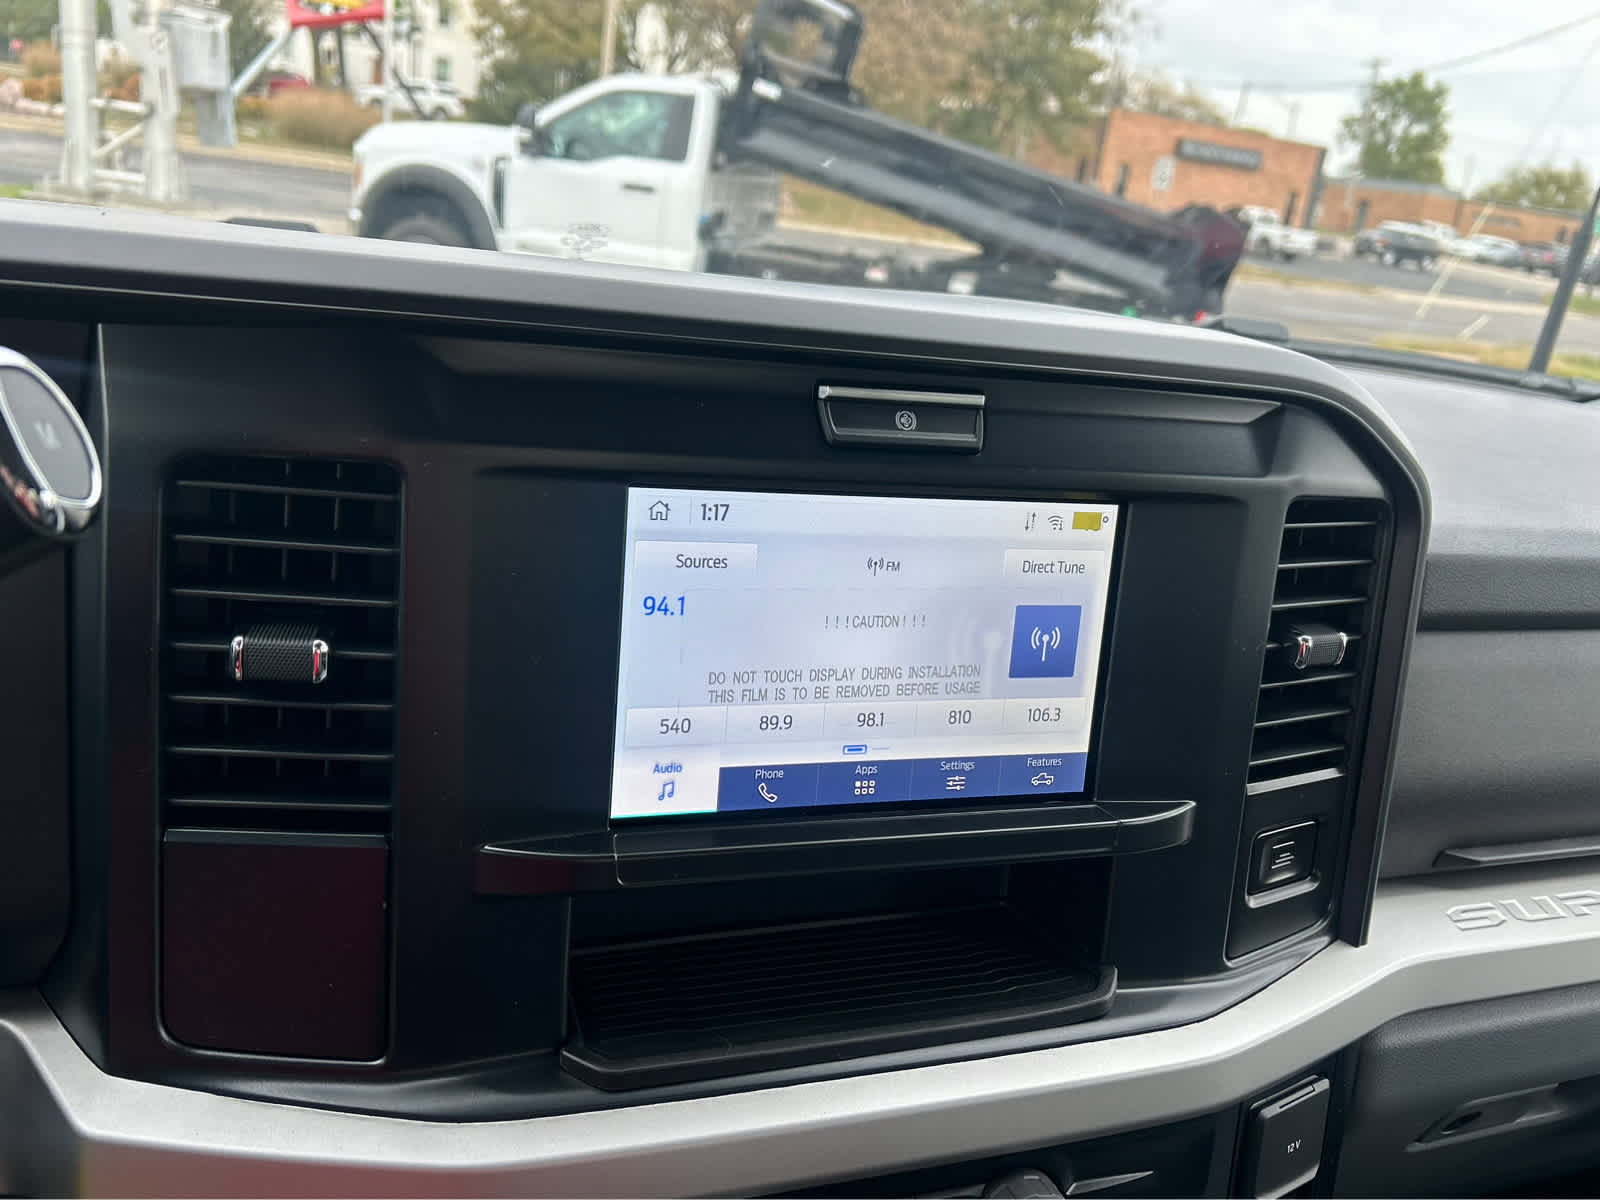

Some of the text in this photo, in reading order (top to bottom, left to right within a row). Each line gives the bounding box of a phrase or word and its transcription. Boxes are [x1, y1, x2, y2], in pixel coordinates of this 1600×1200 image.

[700, 503, 730, 521] 1:17
[675, 553, 728, 569] Sources
[885, 560, 901, 572] FM
[1022, 560, 1086, 574] Direct Tune
[642, 595, 686, 616] 94.1
[708, 664, 981, 685] DO NOT TOUCH DISPLAY DURING INSTALLATION
[707, 680, 981, 704] THIS FILM IS TO BE REMOVED BEFORE USAGE
[759, 714, 793, 732] 89.9
[856, 711, 885, 728] 98.1
[948, 709, 972, 725] 810
[1027, 707, 1062, 723] 106.3
[659, 717, 692, 735] 540
[653, 762, 683, 775] Audio
[855, 764, 878, 776] Apps
[940, 759, 976, 772] Settings
[1026, 756, 1062, 768] Features
[754, 768, 785, 780] Phone
